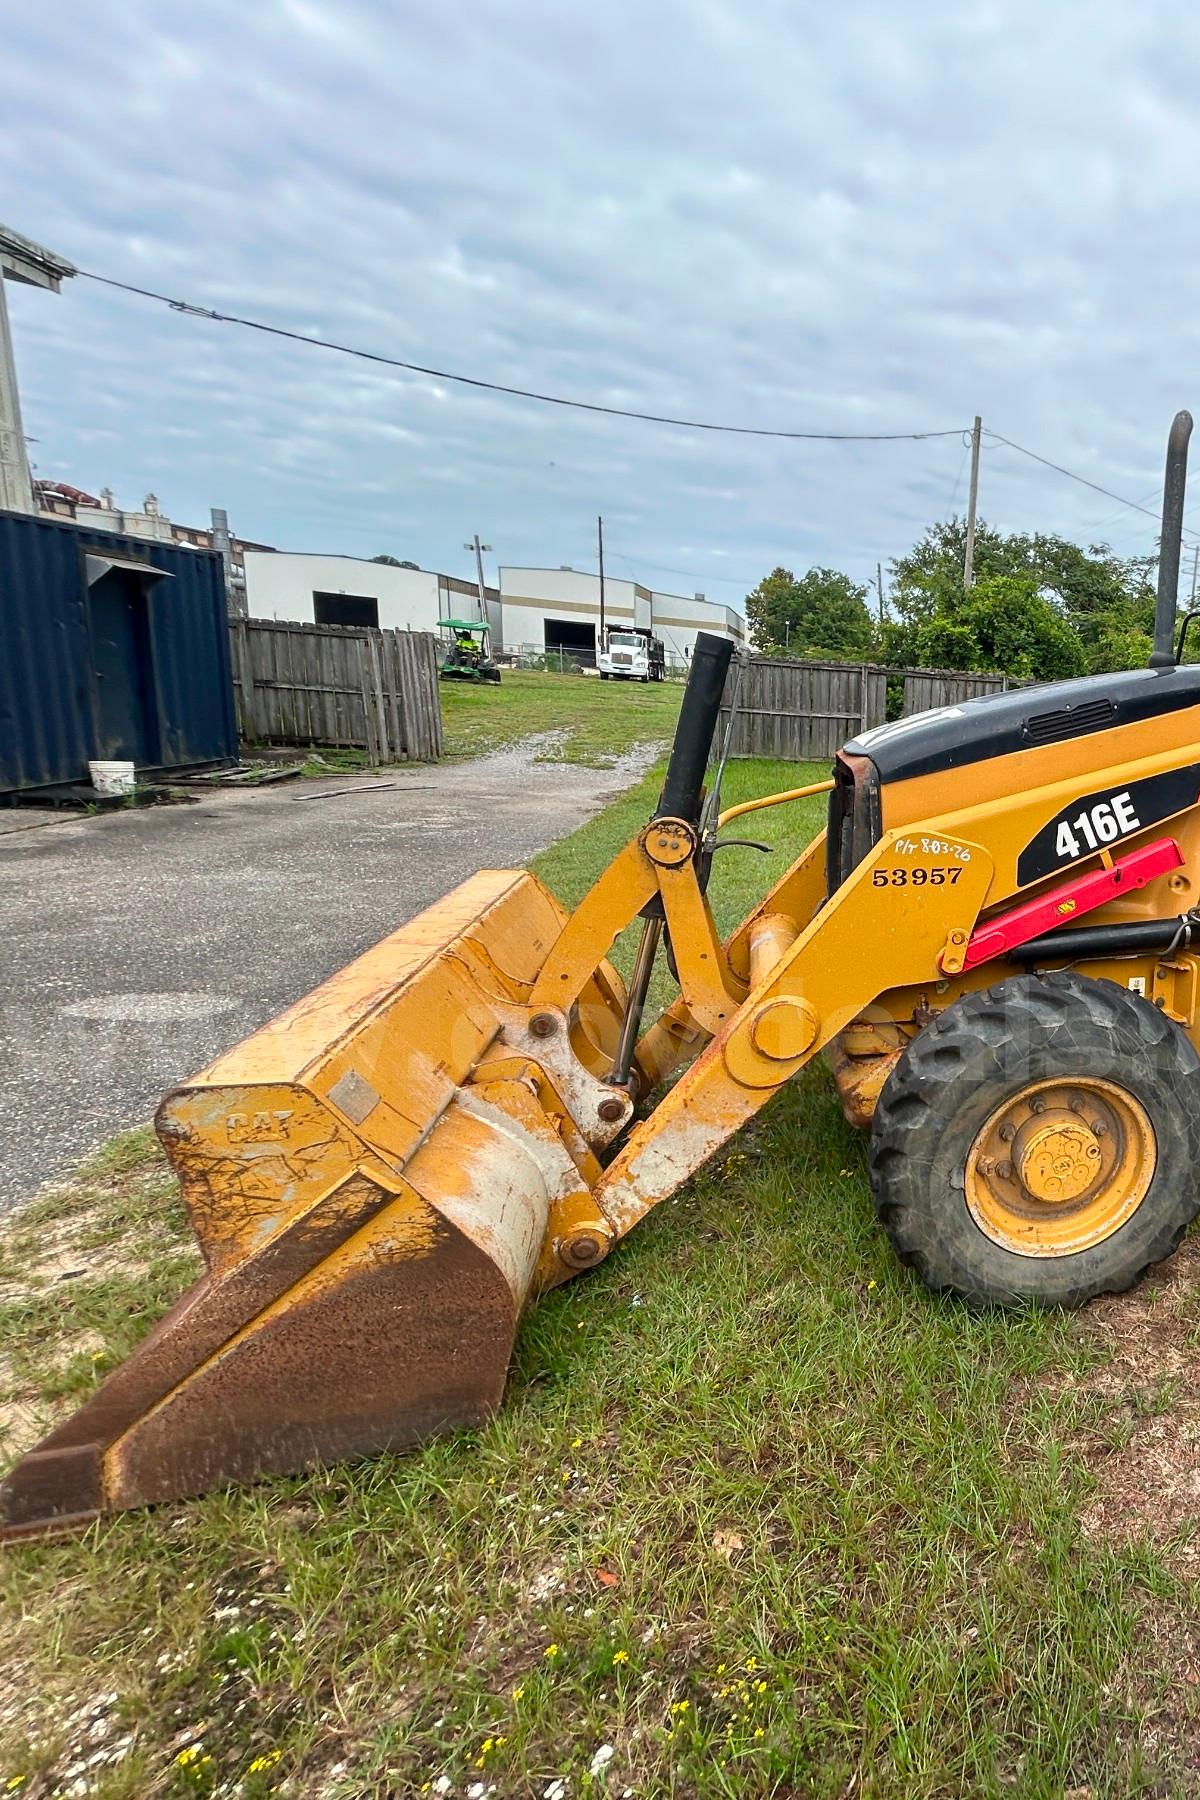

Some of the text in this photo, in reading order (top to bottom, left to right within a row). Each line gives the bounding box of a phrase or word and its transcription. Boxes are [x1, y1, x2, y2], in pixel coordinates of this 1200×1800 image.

[1055, 792, 1141, 858] 416E
[872, 867, 963, 887] 53957
[226, 1110, 294, 1143] CAT
